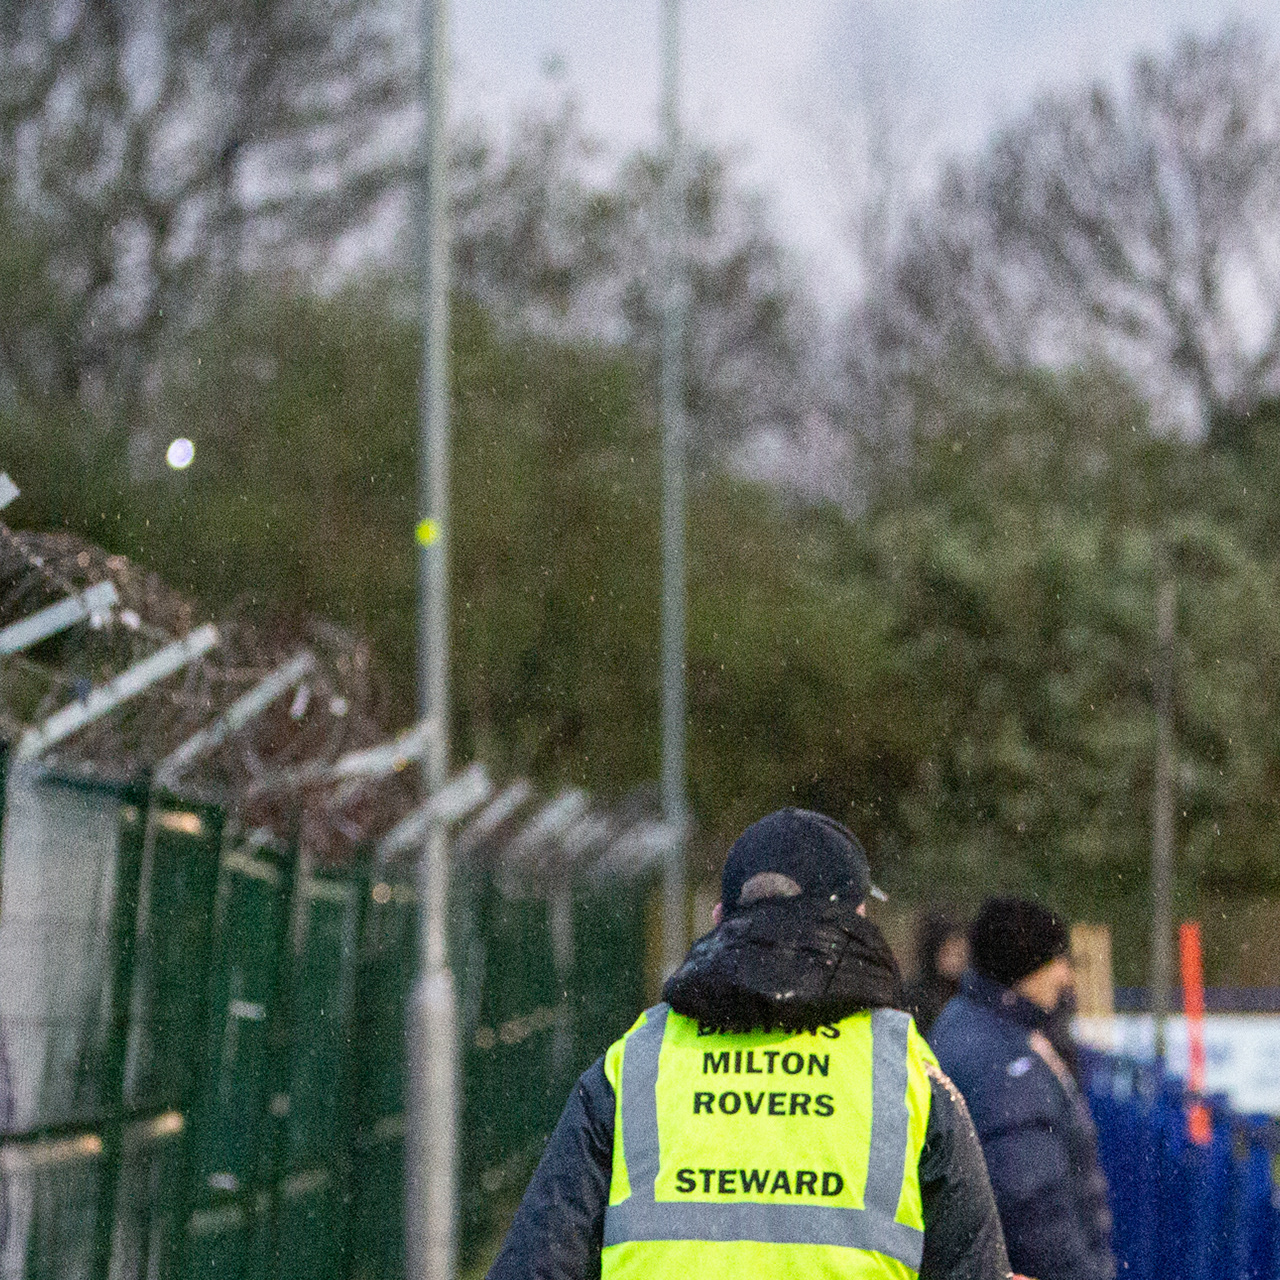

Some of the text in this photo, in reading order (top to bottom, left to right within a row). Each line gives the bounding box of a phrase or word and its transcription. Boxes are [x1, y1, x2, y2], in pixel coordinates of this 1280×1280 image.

[703, 1050, 830, 1077] MILTON
[693, 1090, 835, 1117] ROVERS
[675, 1168, 844, 1197] STEWARD
